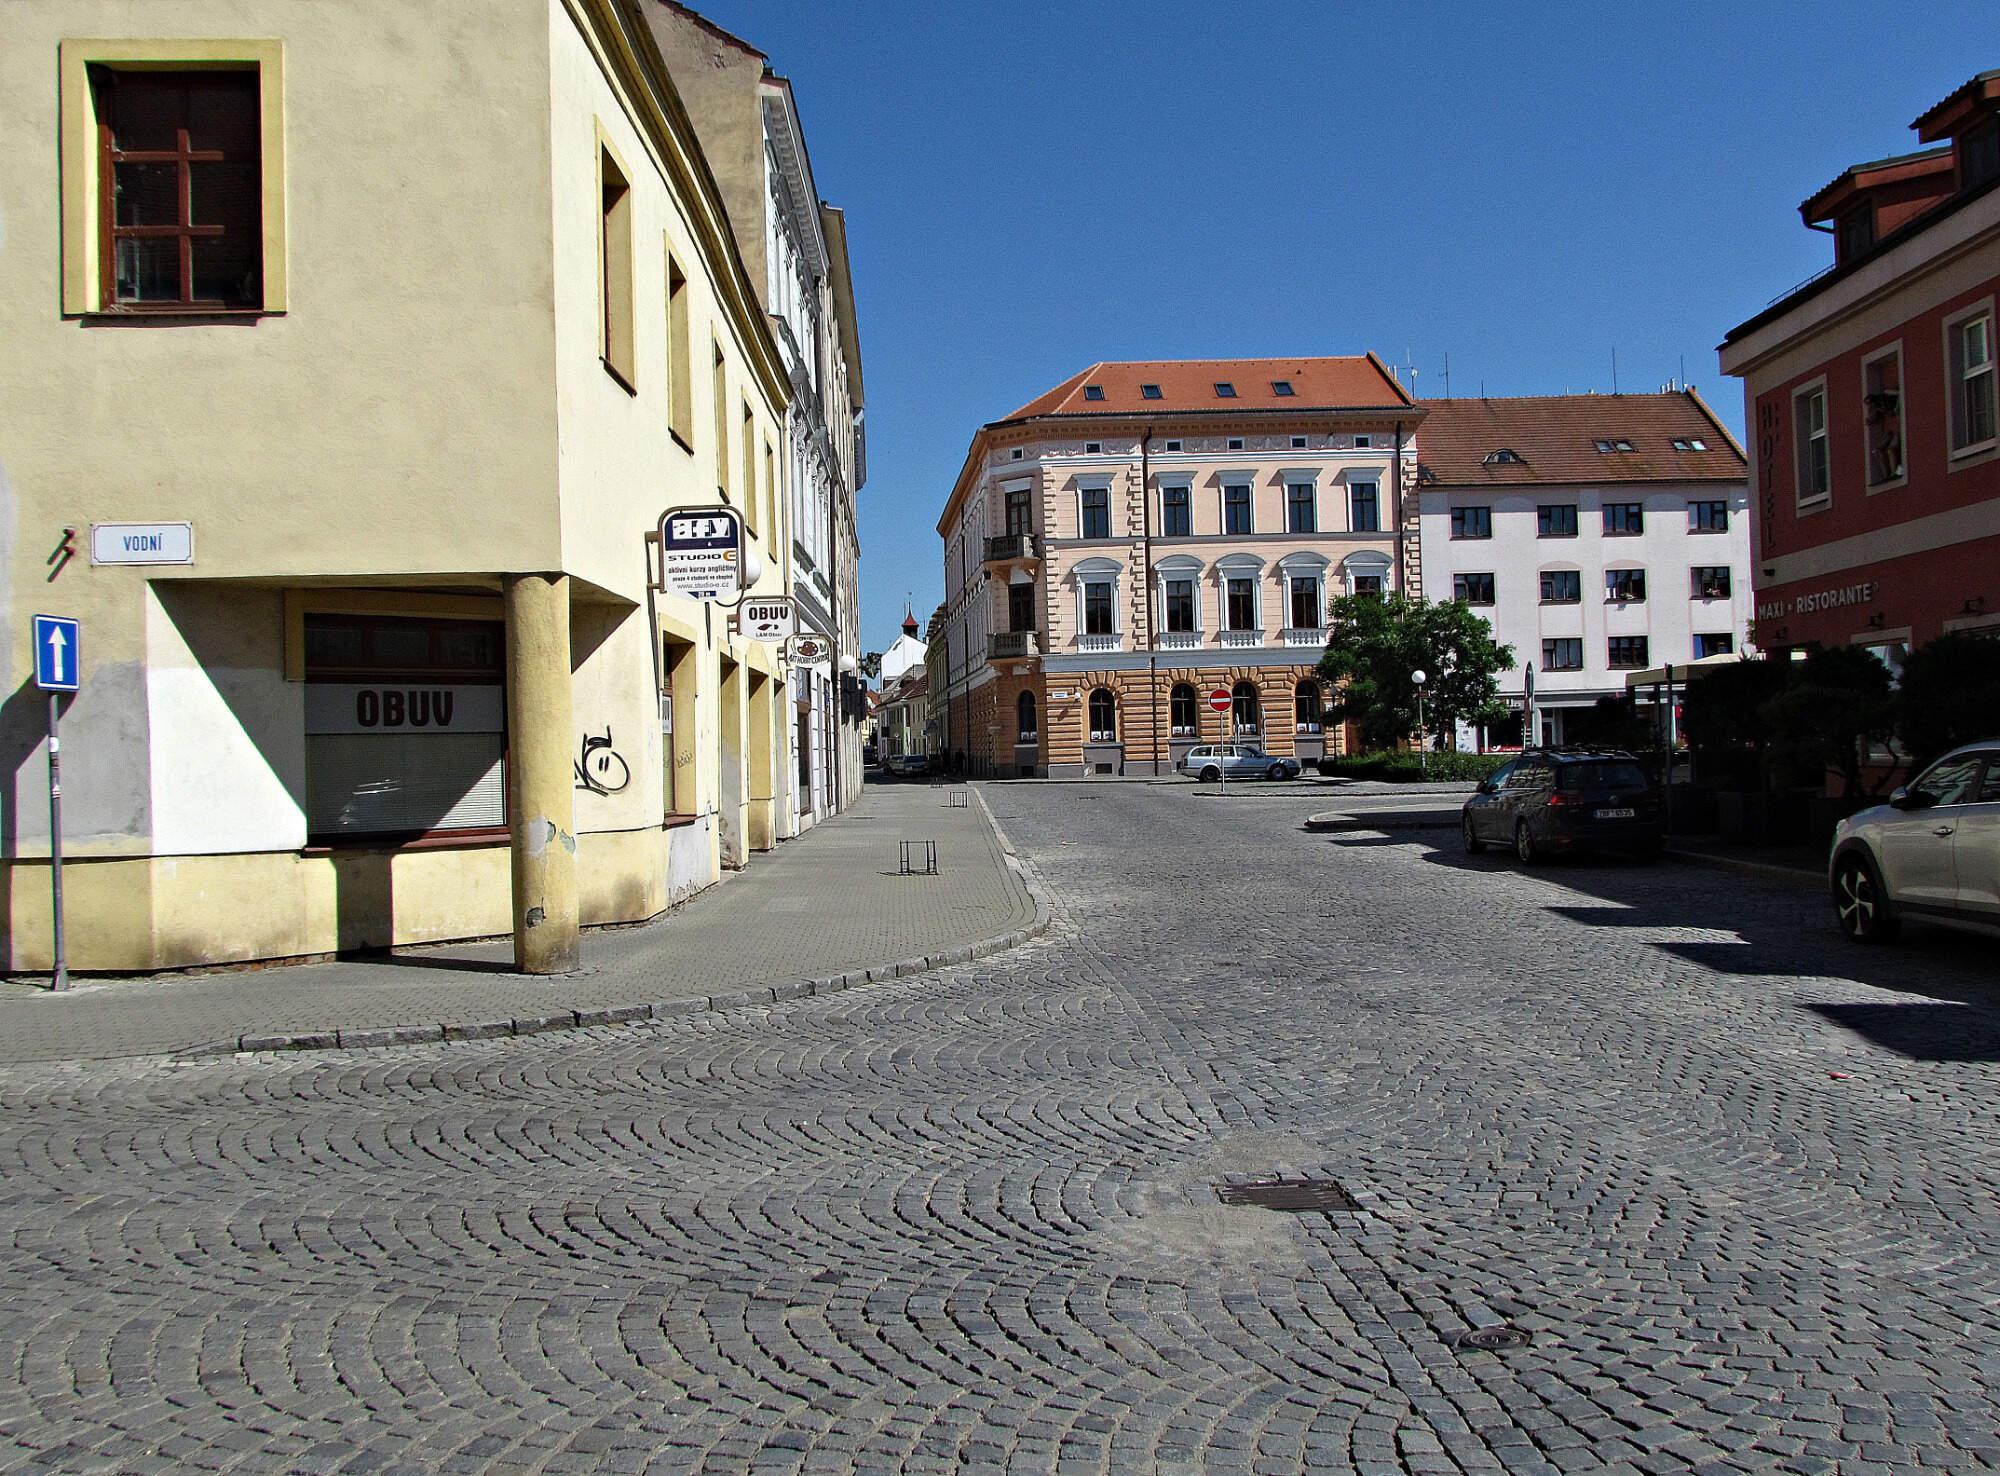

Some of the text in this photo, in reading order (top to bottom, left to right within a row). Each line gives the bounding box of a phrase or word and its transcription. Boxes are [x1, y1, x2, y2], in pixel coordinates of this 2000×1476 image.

[123, 532, 163, 551] VODNÍ
[689, 565, 706, 573] kurzy
[1796, 583, 1872, 614] RISTORANTE
[748, 606, 788, 620] OBUV
[357, 690, 453, 727] OBUV
